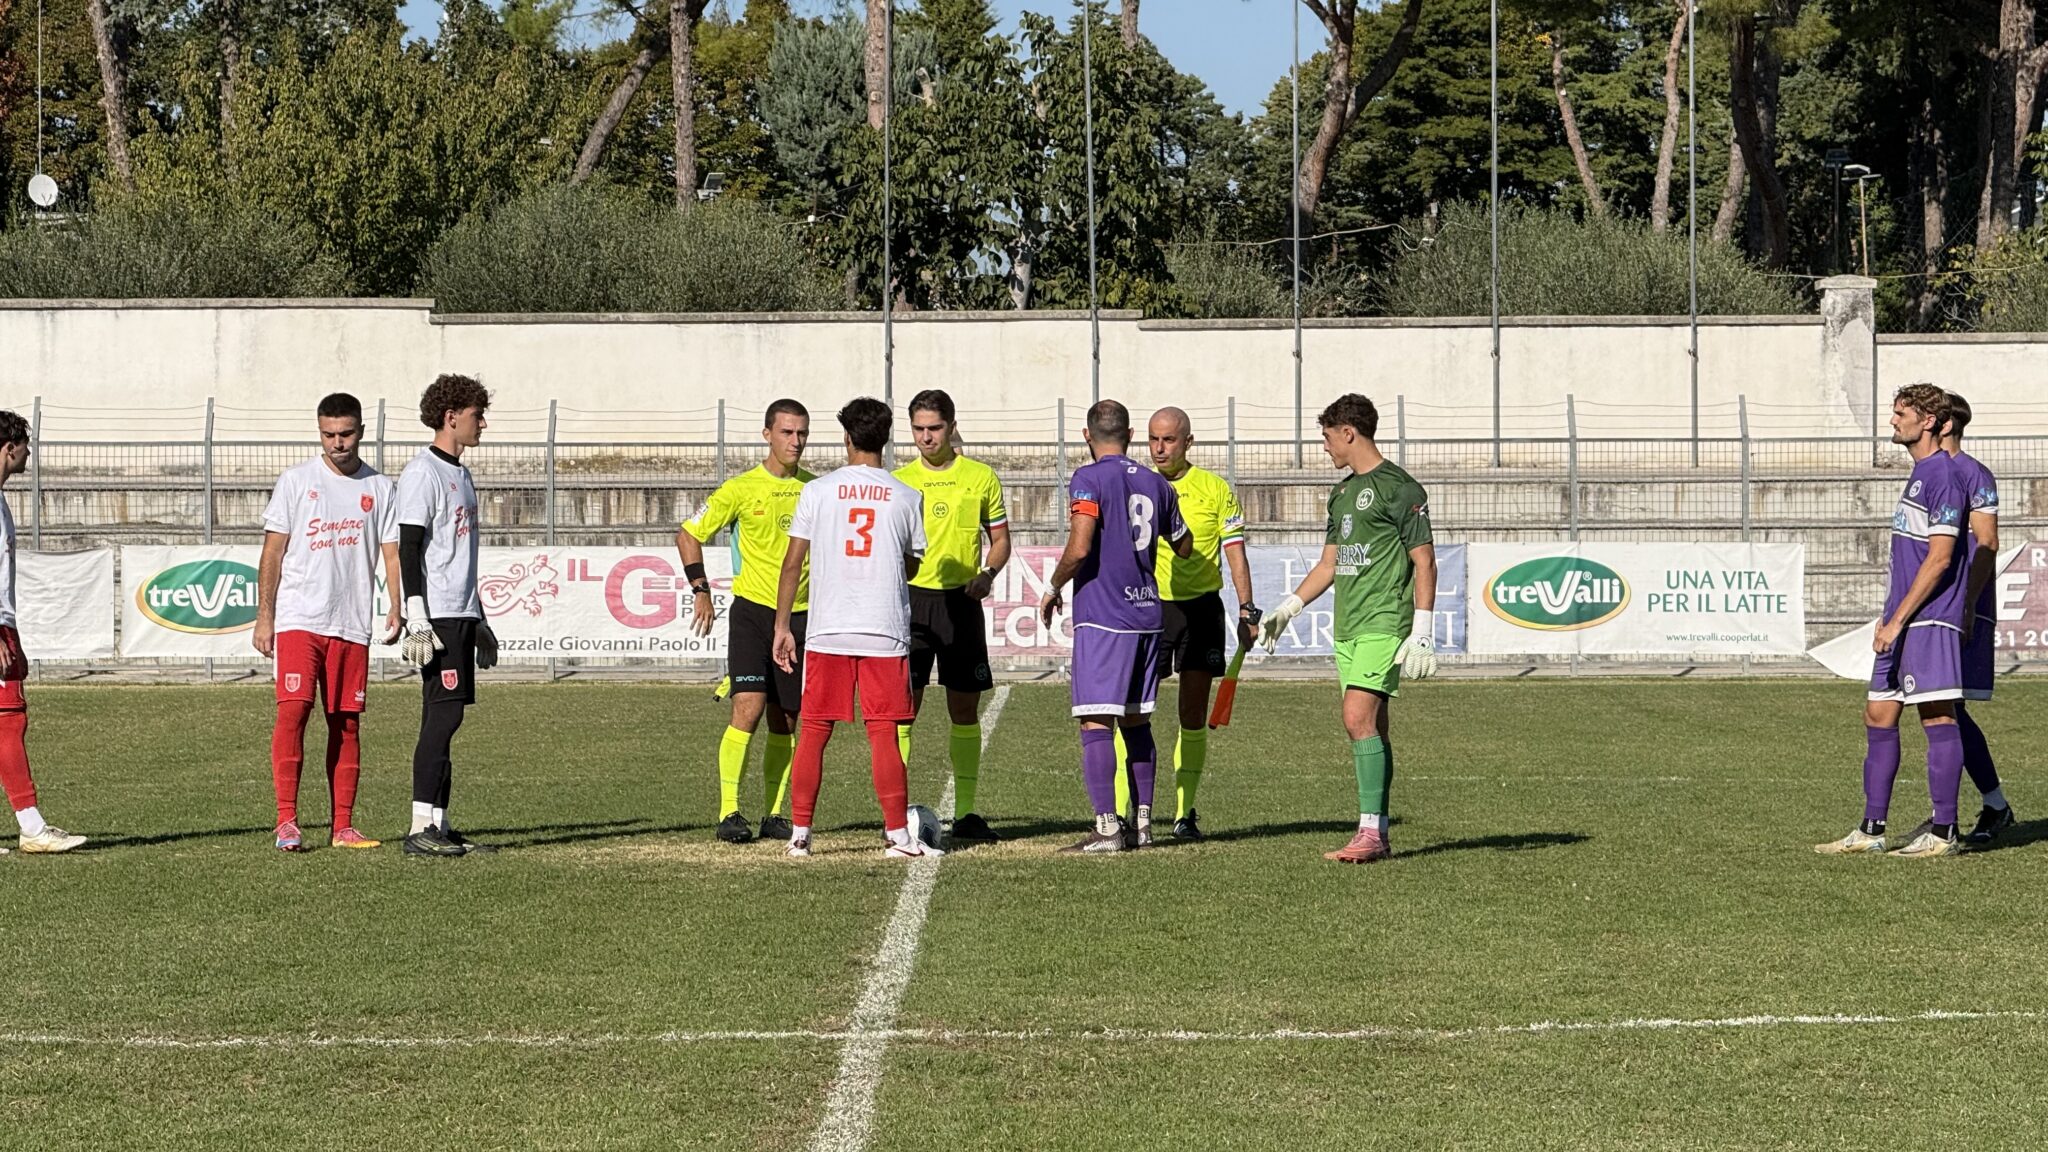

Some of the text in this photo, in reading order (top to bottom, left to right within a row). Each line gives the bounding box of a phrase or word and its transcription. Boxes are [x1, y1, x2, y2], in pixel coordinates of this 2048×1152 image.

[838, 484, 893, 501] DAVIDE
[306, 517, 364, 537] Sempre
[845, 507, 876, 558] 3
[1128, 493, 1154, 552] 8
[310, 533, 360, 551] con noi
[567, 558, 604, 582] IL
[1666, 570, 1769, 590] UNA VITA
[681, 594, 726, 606] BR
[1647, 593, 1788, 614] PER IL LATTE
[497, 636, 554, 651] azzale
[559, 636, 643, 651] Giovanni
[649, 637, 701, 651] Paolo
[1666, 632, 1769, 644] www.trevalli.cooperlat.it
